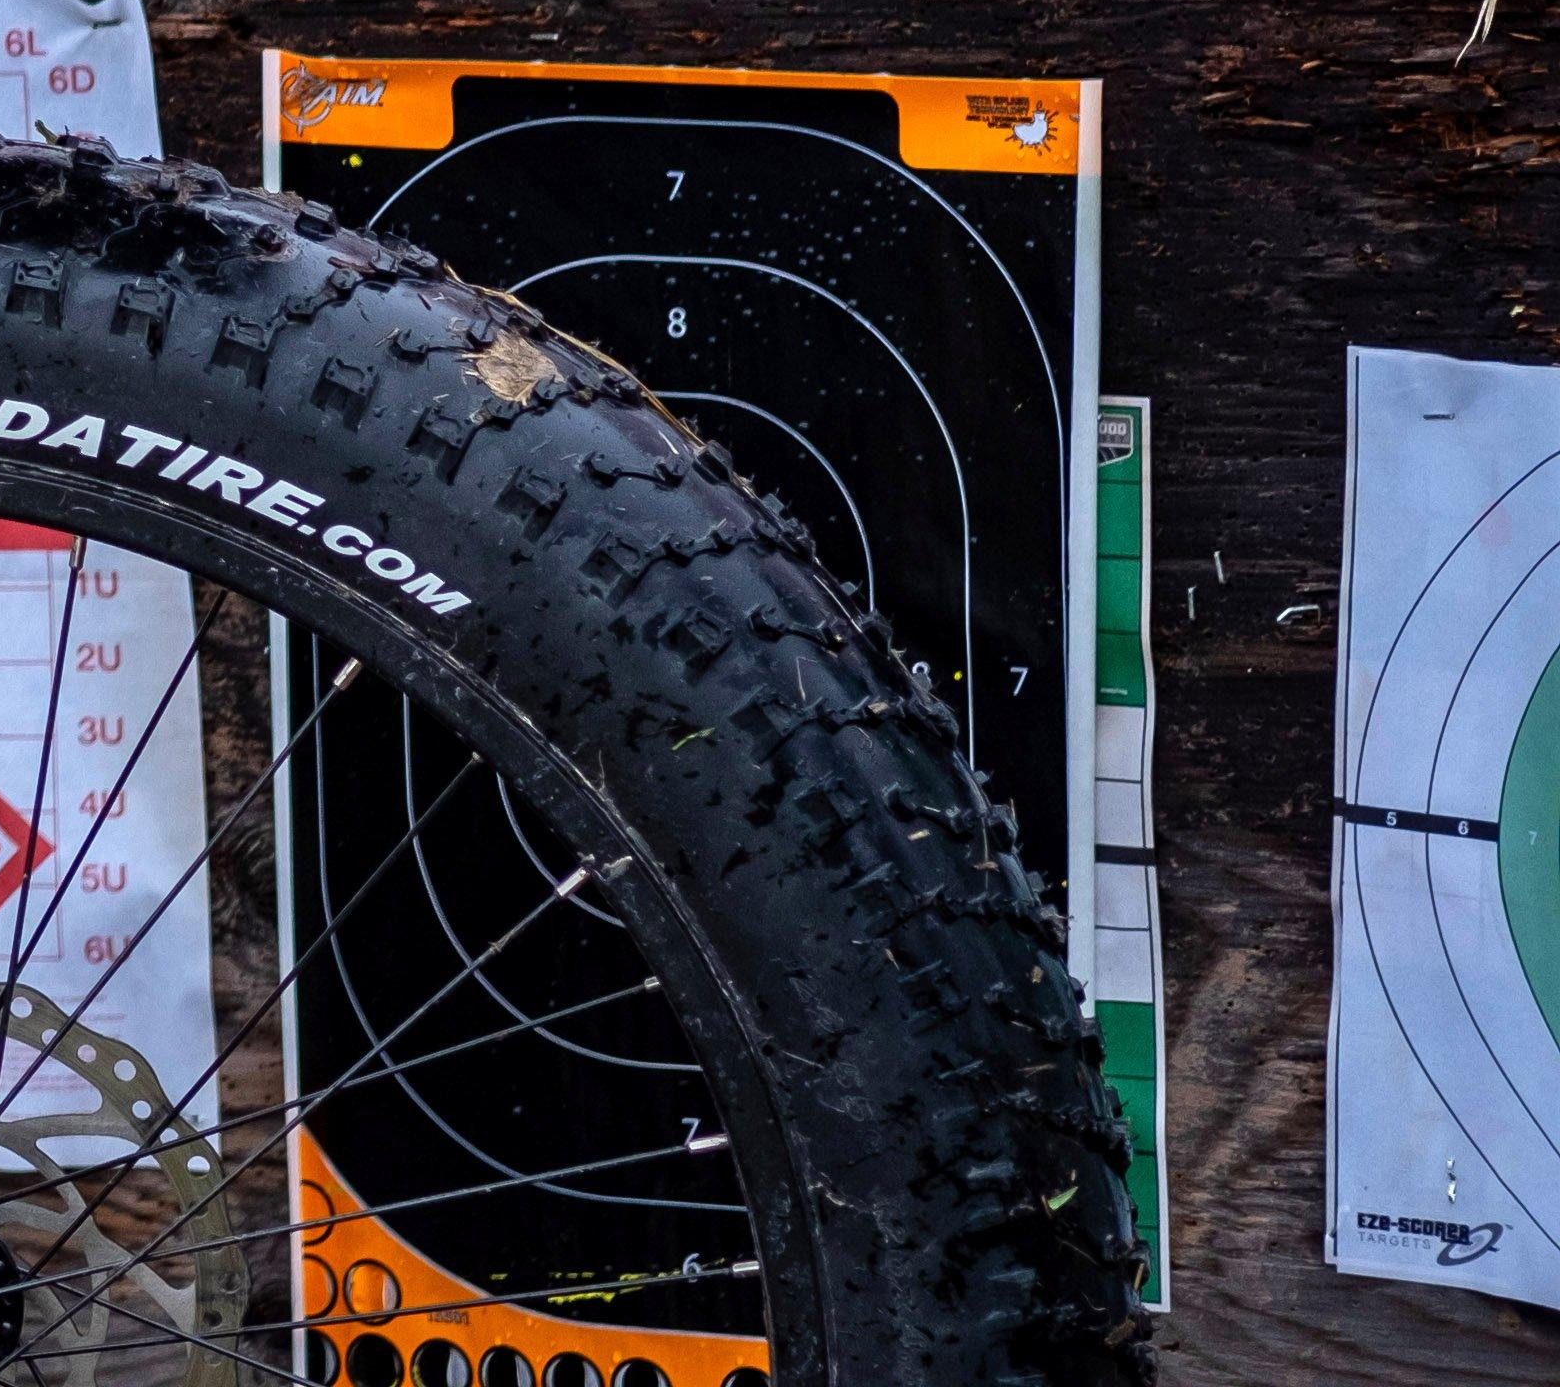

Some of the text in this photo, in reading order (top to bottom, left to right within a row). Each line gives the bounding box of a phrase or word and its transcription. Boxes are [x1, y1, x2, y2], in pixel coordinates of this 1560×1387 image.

[5, 30, 44, 57] 6L
[49, 66, 94, 94] 6D
[667, 171, 685, 200] 7
[668, 308, 686, 337] 8
[79, 572, 117, 597] 1U
[78, 643, 121, 671] 2U
[1011, 667, 1028, 695] 7
[78, 717, 124, 745] 3U
[80, 789, 127, 819] 4U
[1386, 812, 1538, 846] 5 6 7
[83, 866, 125, 892] 5U
[84, 934, 133, 965] 6U
[681, 1118, 701, 1146] 7
[1358, 1231, 1432, 1250] TARGETS
[681, 1253, 701, 1284] 6
